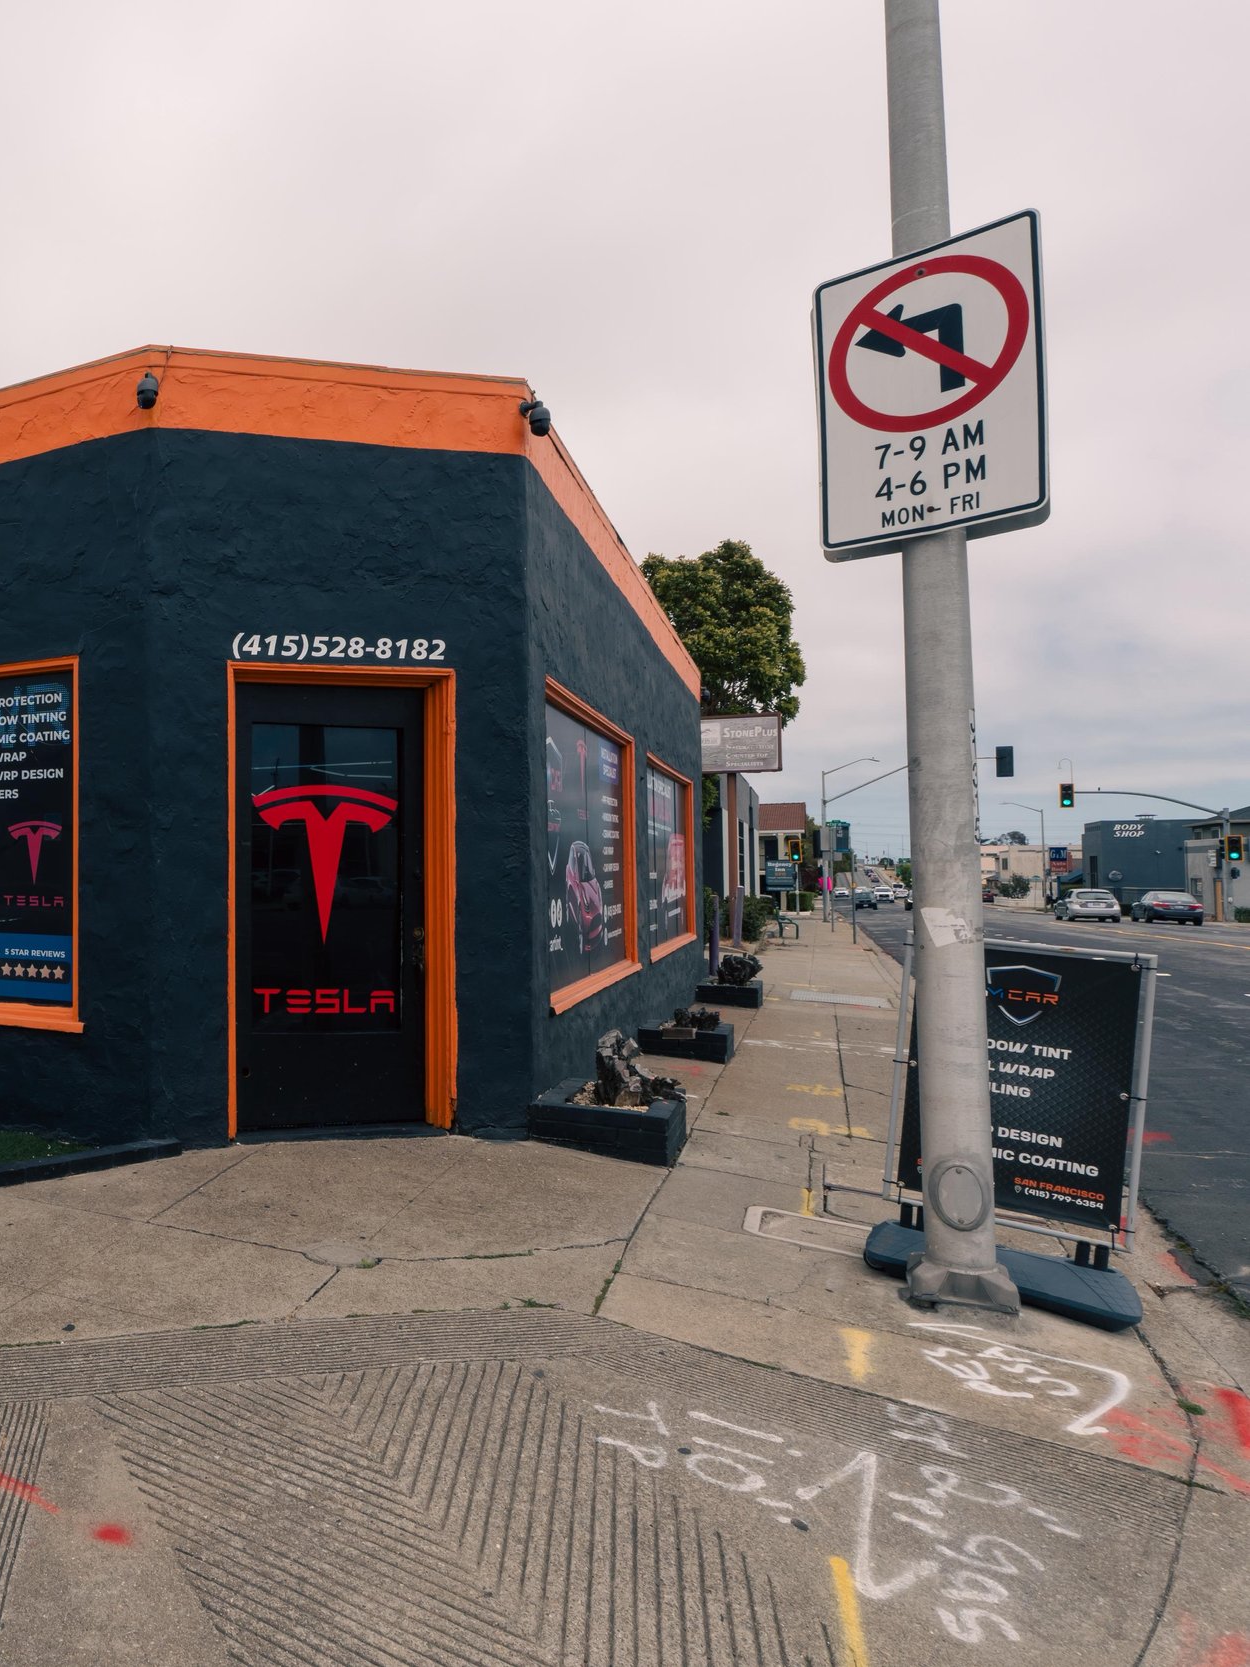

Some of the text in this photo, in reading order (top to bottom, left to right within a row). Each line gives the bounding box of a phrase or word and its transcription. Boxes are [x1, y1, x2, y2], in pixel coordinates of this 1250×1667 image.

[875, 419, 985, 470] 7-9 AM
[875, 455, 987, 501] 4-6 PM
[881, 505, 924, 528] MON
[950, 492, 980, 515] FRI
[232, 632, 446, 660] (415)528-8182
[21, 711, 67, 725] TINTING
[19, 730, 70, 744] COATING
[21, 768, 64, 780] DESIGN
[1113, 823, 1144, 831] BODY
[1113, 830, 1145, 838] SHOP
[3, 895, 64, 907] TESLA
[10, 949, 29, 957] STAR
[30, 949, 65, 959] REVIEWS
[253, 988, 395, 1014] TESLA
[1031, 1045, 1072, 1061] TINT
[999, 1062, 1055, 1079] WRAP
[997, 1126, 1062, 1149] DESIGN
[1018, 1152, 1099, 1178] COATING
[1014, 1177, 1105, 1201] SAN FRANCISCO
[1024, 1187, 1104, 1210] (415) 799-6354
